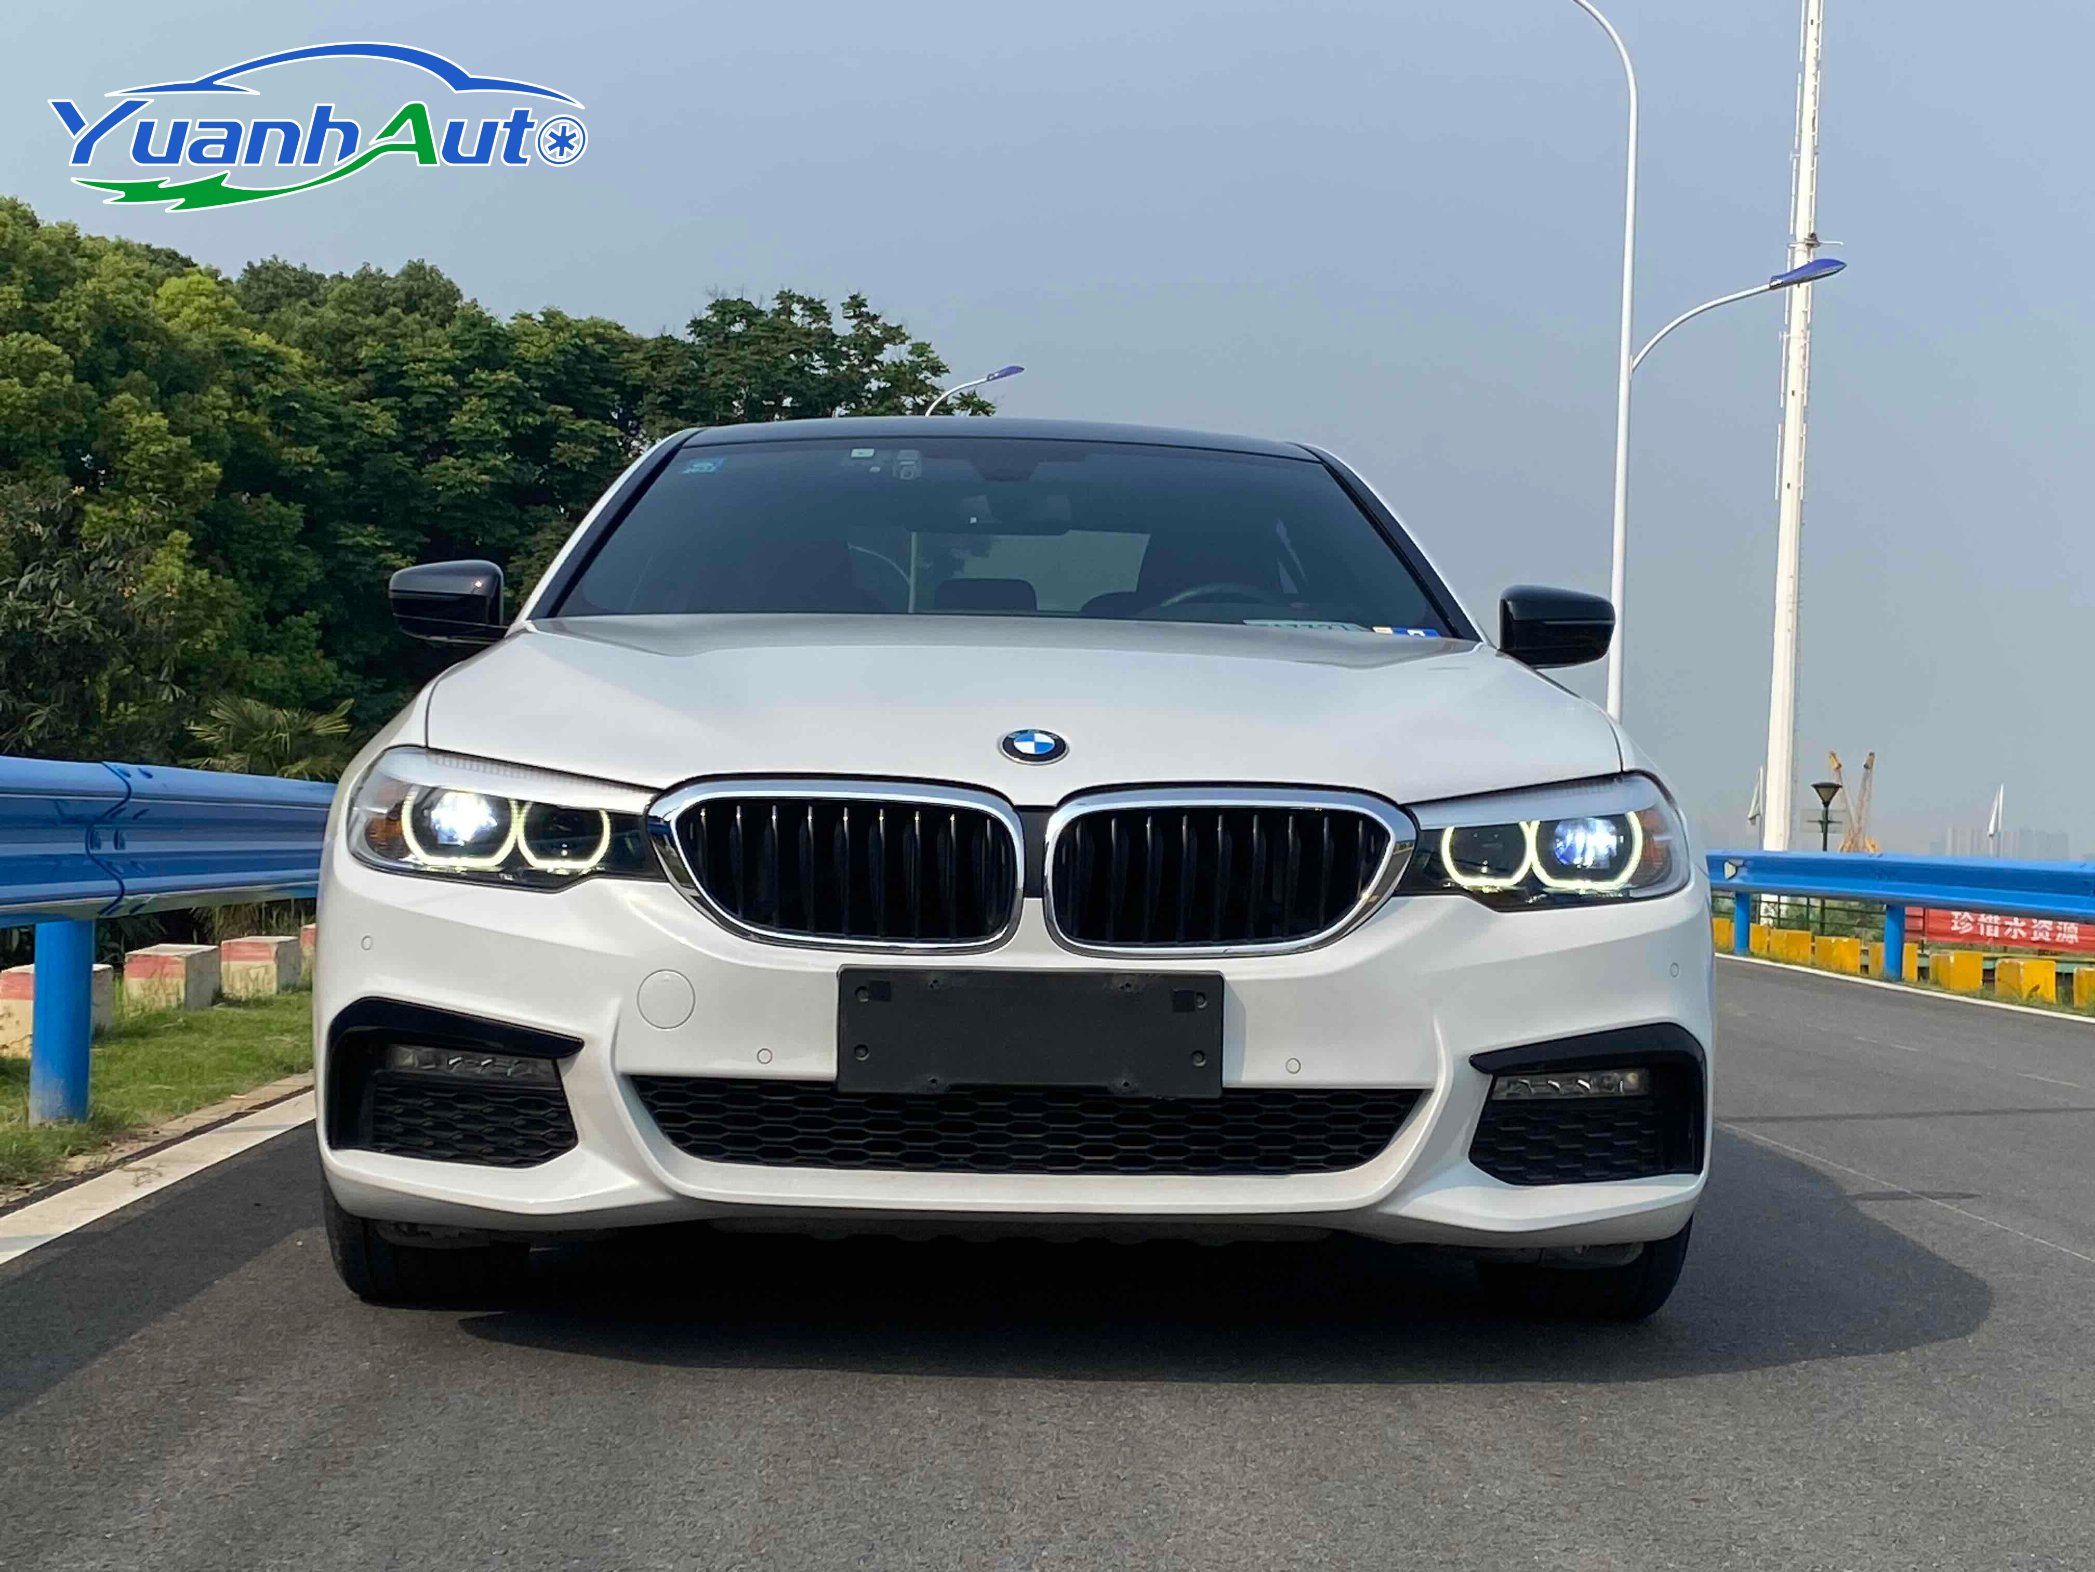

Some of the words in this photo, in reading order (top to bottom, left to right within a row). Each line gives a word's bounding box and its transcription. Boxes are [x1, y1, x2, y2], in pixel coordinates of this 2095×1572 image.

[1950, 910, 2080, 945] 珍惜水资源
